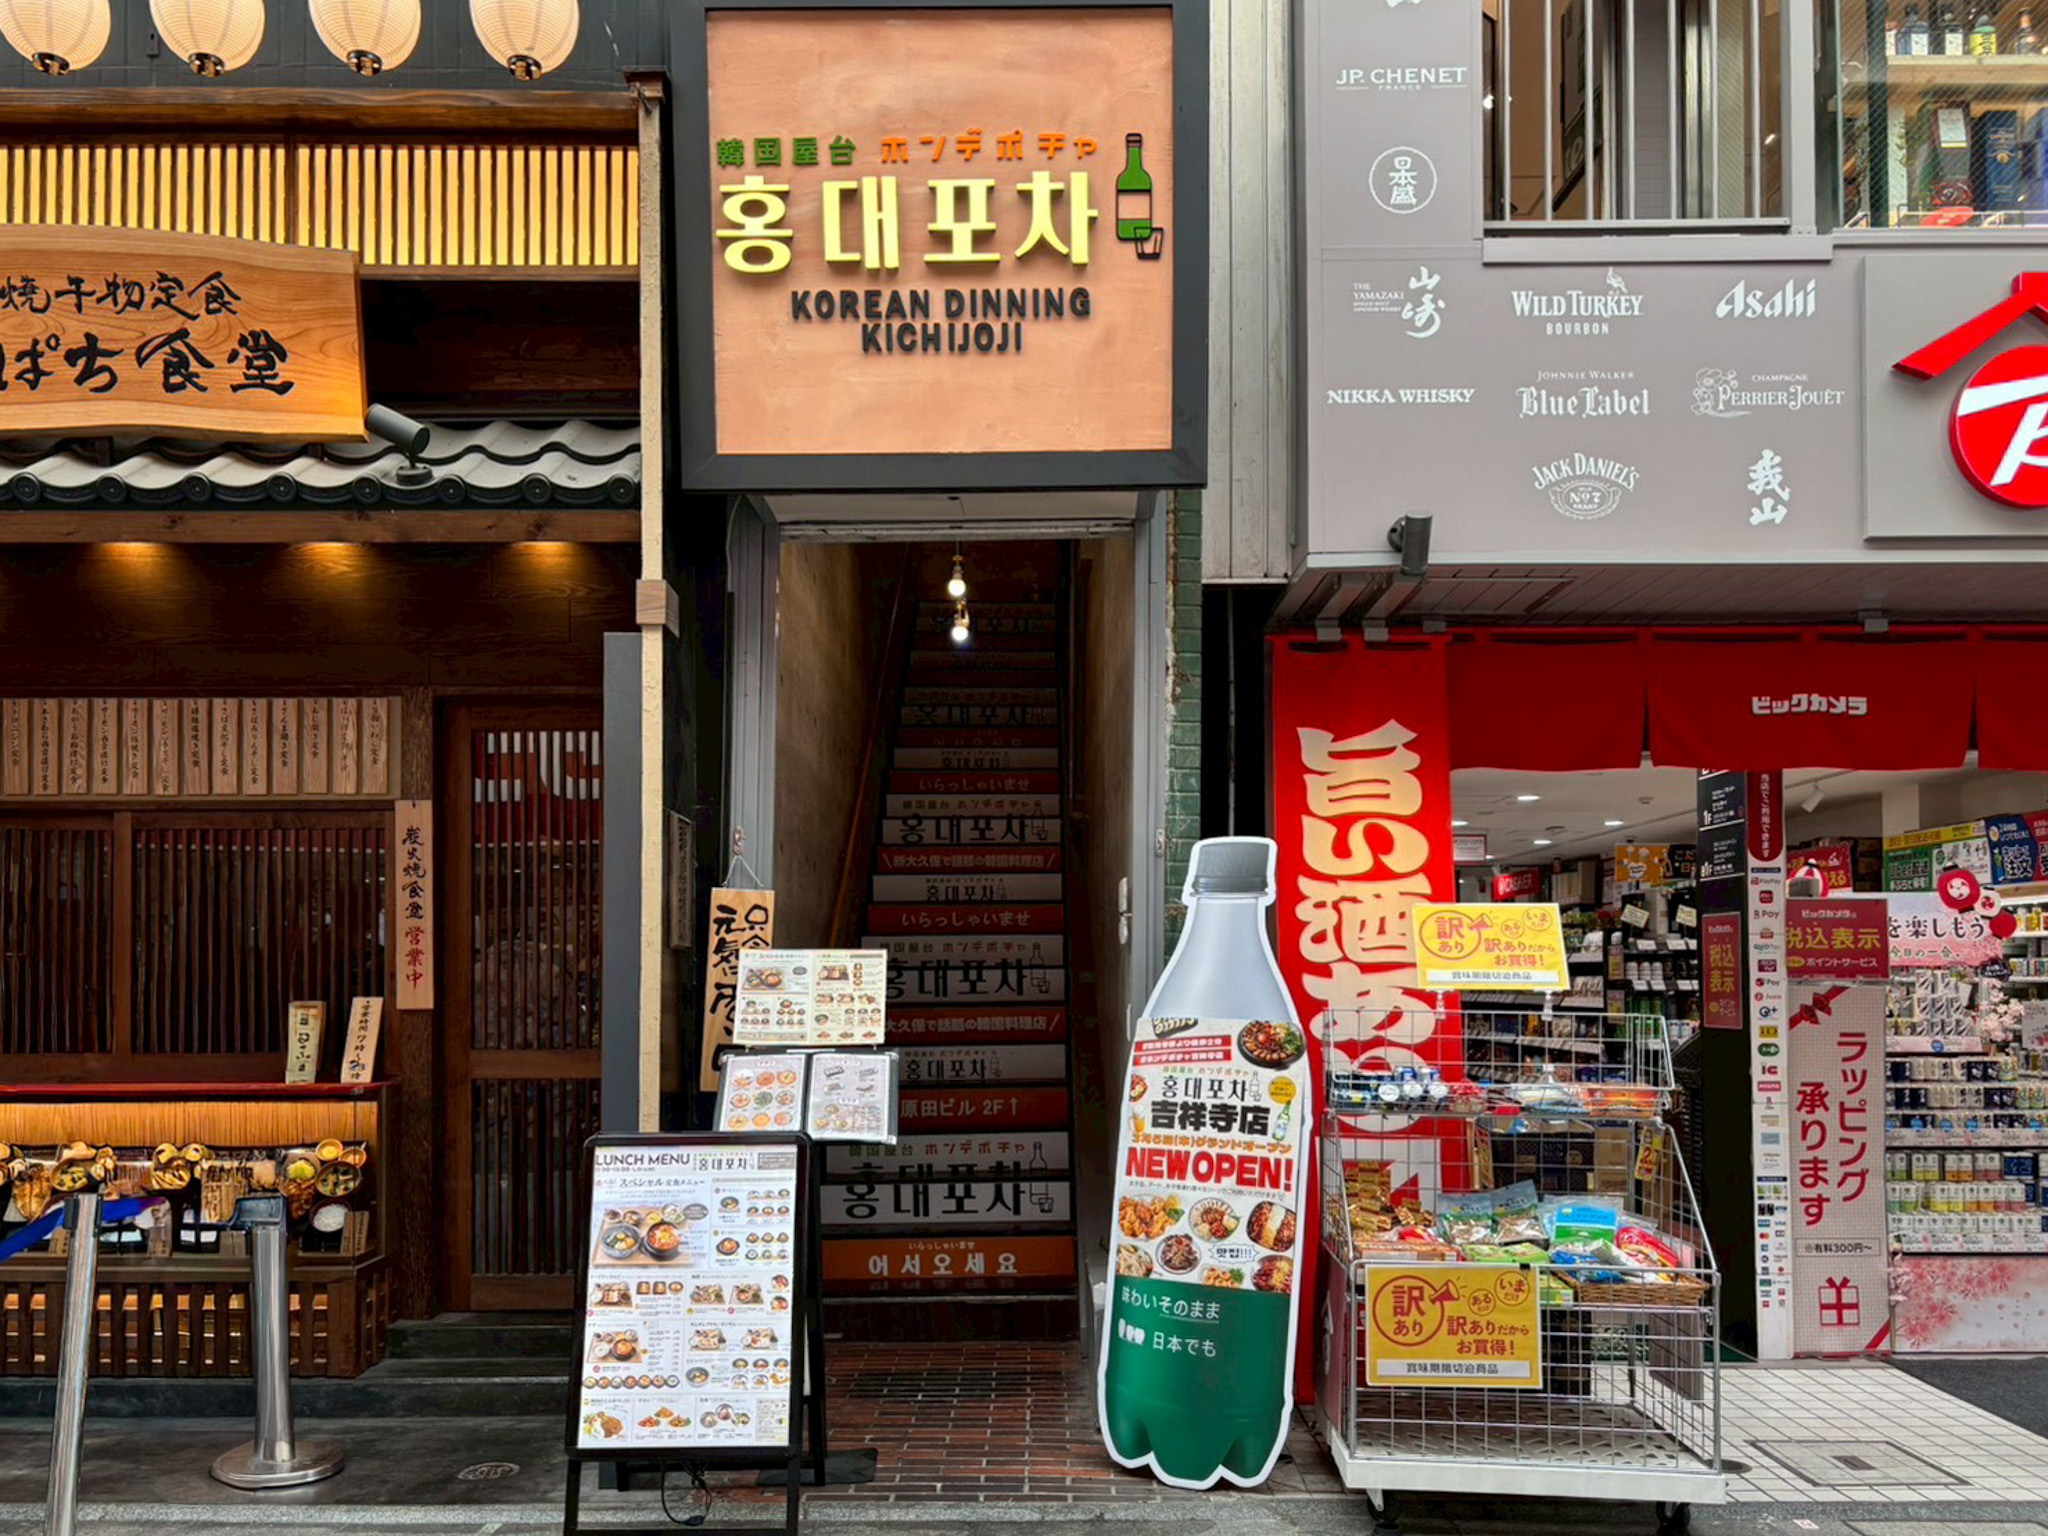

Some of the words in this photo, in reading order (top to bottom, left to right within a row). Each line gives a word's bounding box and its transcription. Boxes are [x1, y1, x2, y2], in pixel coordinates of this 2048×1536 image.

[1370, 67, 1467, 84] CHENET
[715, 136, 857, 168] 韓国屋台
[880, 128, 1098, 164] ホンデポチャ
[715, 170, 1100, 274] 홍대포차
[790, 289, 931, 321] KOREAN
[945, 286, 1092, 319] DINNING
[1353, 291, 1404, 300] YAMAZAKI
[1511, 290, 1566, 317] WILD
[1566, 290, 1643, 319] TURKEY
[1715, 279, 1816, 319] Asahi
[861, 322, 1023, 354] KICHIJOJI
[1546, 322, 1610, 335] BOURBON
[1751, 373, 1809, 382] CHAMPAGNE
[1326, 388, 1396, 404] NIKKA
[1398, 388, 1475, 403] WHISKY
[1515, 385, 1578, 419] Blue
[1579, 385, 1651, 419] Label
[1532, 459, 1574, 490] JACK
[1751, 692, 1868, 715] ビックカメラ
[918, 777, 1031, 792] いらっしゃいませ
[901, 911, 1031, 928] いらっしゃいませ
[1434, 916, 1465, 940] 訳
[1438, 940, 1465, 954] あり
[1785, 926, 1882, 949] 税込表示
[1806, 956, 1878, 968] ポイントサービス
[1161, 1075, 1249, 1102] 홍대포차
[982, 1098, 1003, 1116] 2F
[1150, 1100, 1271, 1136] 吉祥寺店
[1837, 1032, 1869, 1202] ラッピング
[924, 1139, 1026, 1155] ホンデポチャ
[1796, 1082, 1831, 1226] 承ります
[595, 1153, 644, 1166] LUNCH
[648, 1153, 690, 1165] MENU
[1126, 1146, 1191, 1181] NEW
[1191, 1150, 1294, 1192] OPEN!
[842, 1161, 1026, 1219] 홍대포차
[867, 1252, 1019, 1276] 어서오세요
[1499, 1278, 1528, 1294] いま
[1121, 1286, 1222, 1320] 味わいそのまま
[1391, 1284, 1426, 1318] 訳
[1471, 1293, 1493, 1306] ある
[1393, 1318, 1424, 1337] あり
[1446, 1315, 1530, 1337] 訳ありだから
[1152, 1330, 1217, 1358] 日本でも
[1456, 1338, 1515, 1356] お買得!
[1406, 1361, 1499, 1375] 賞味期限切迫商品
